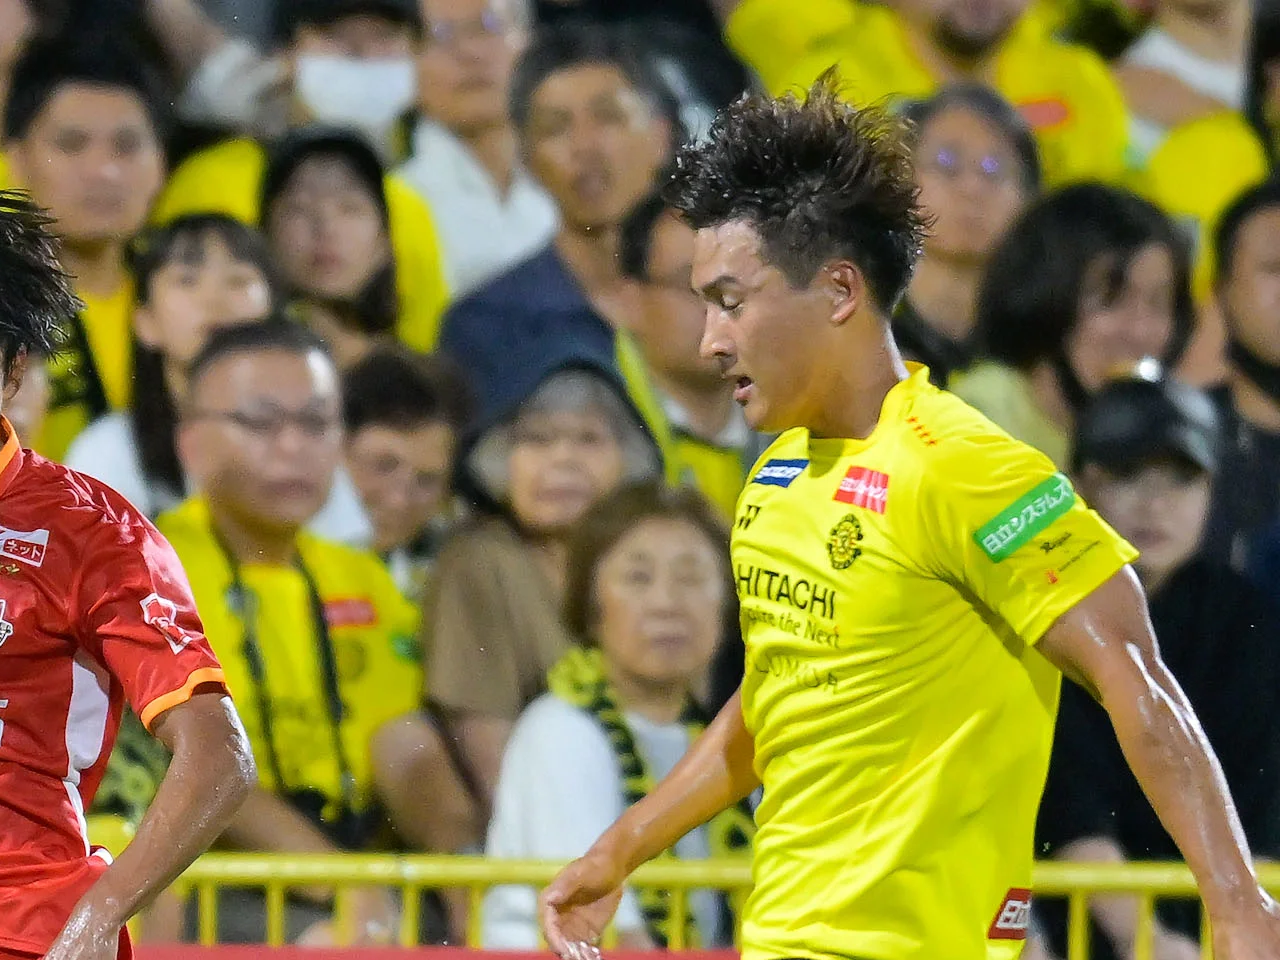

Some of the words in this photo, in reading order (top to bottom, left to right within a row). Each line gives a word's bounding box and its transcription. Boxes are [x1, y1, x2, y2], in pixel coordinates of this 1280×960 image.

[5, 540, 42, 560] ネット
[738, 563, 836, 620] HITACHI
[779, 612, 801, 636] the
[803, 617, 840, 649] Next
